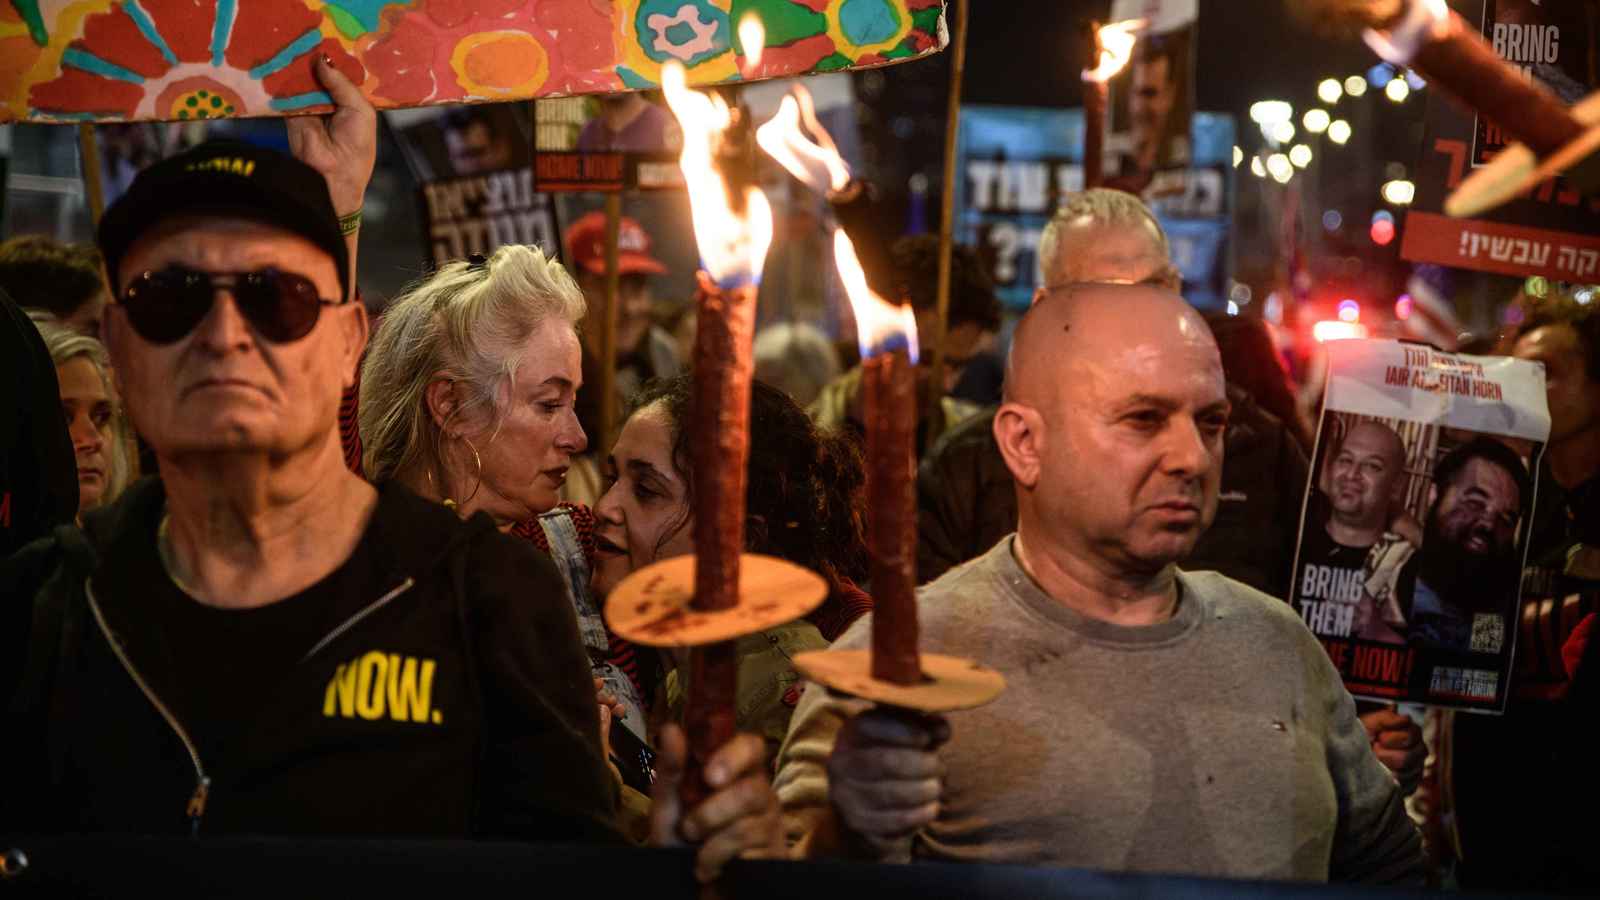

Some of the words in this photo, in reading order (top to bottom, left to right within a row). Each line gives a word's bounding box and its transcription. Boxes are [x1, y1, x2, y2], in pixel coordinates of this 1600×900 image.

[1492, 23, 1559, 63] BRING
[1459, 231, 1551, 267] עכשיו!
[1384, 365, 1409, 387] IAIR
[1472, 380, 1503, 401] HORN
[1301, 563, 1365, 604] BRING
[1300, 599, 1355, 638] THEM
[322, 650, 444, 725] NOW.
